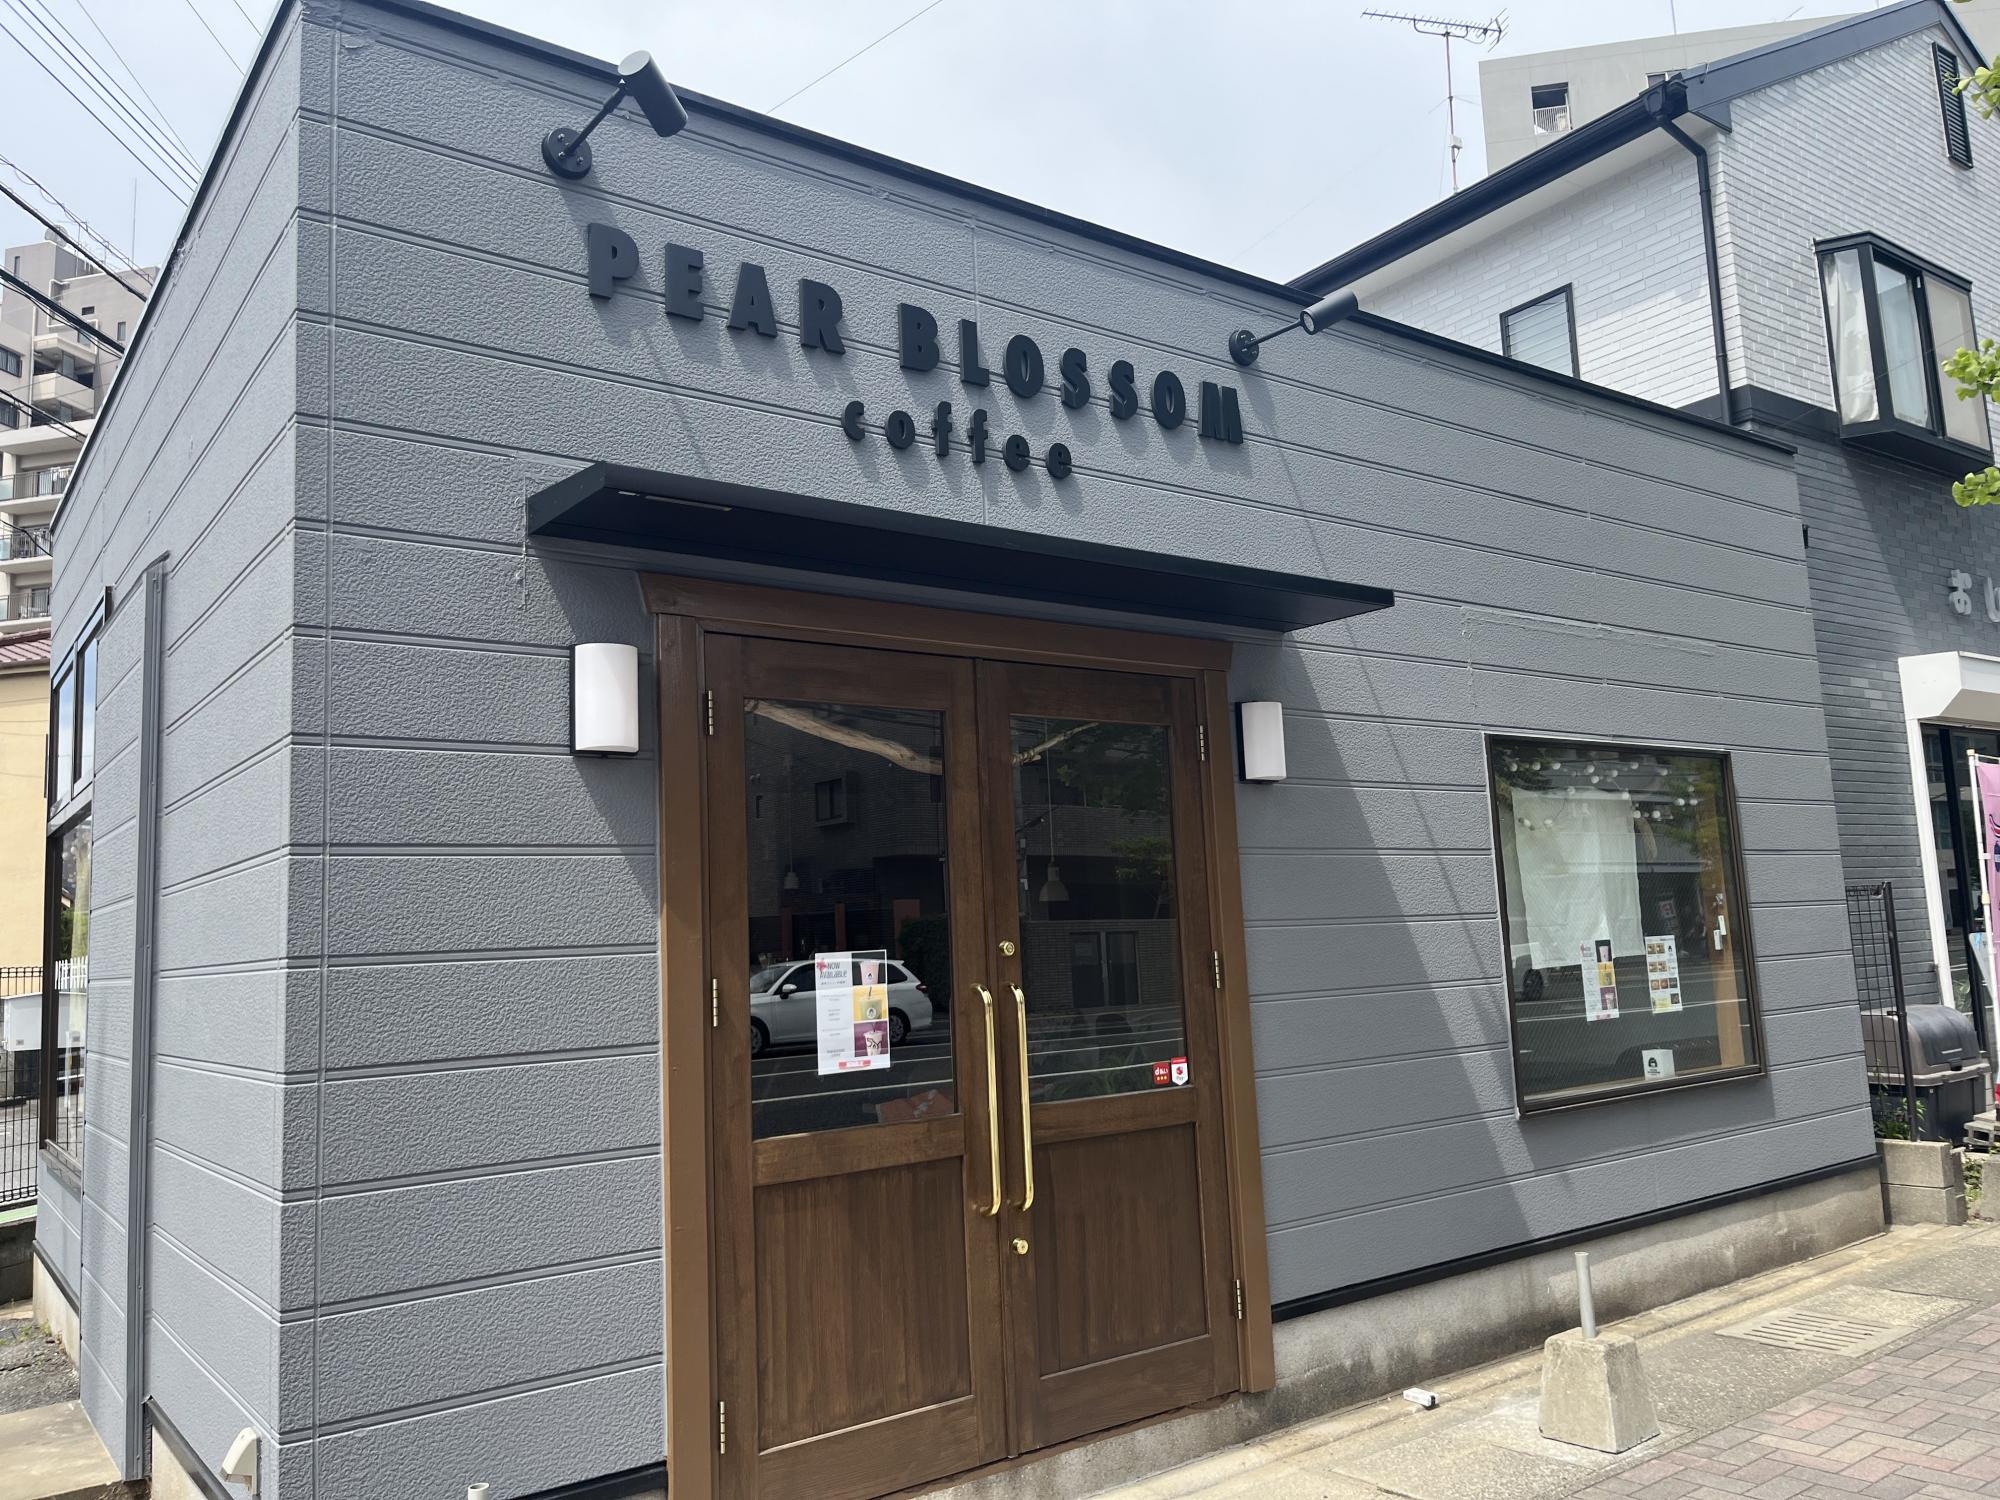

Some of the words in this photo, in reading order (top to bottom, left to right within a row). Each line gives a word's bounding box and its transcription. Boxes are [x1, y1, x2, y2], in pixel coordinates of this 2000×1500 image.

[588, 222, 845, 355] PEAR
[899, 302, 1244, 444] BLOSSOM
[841, 399, 1072, 479] coffee
